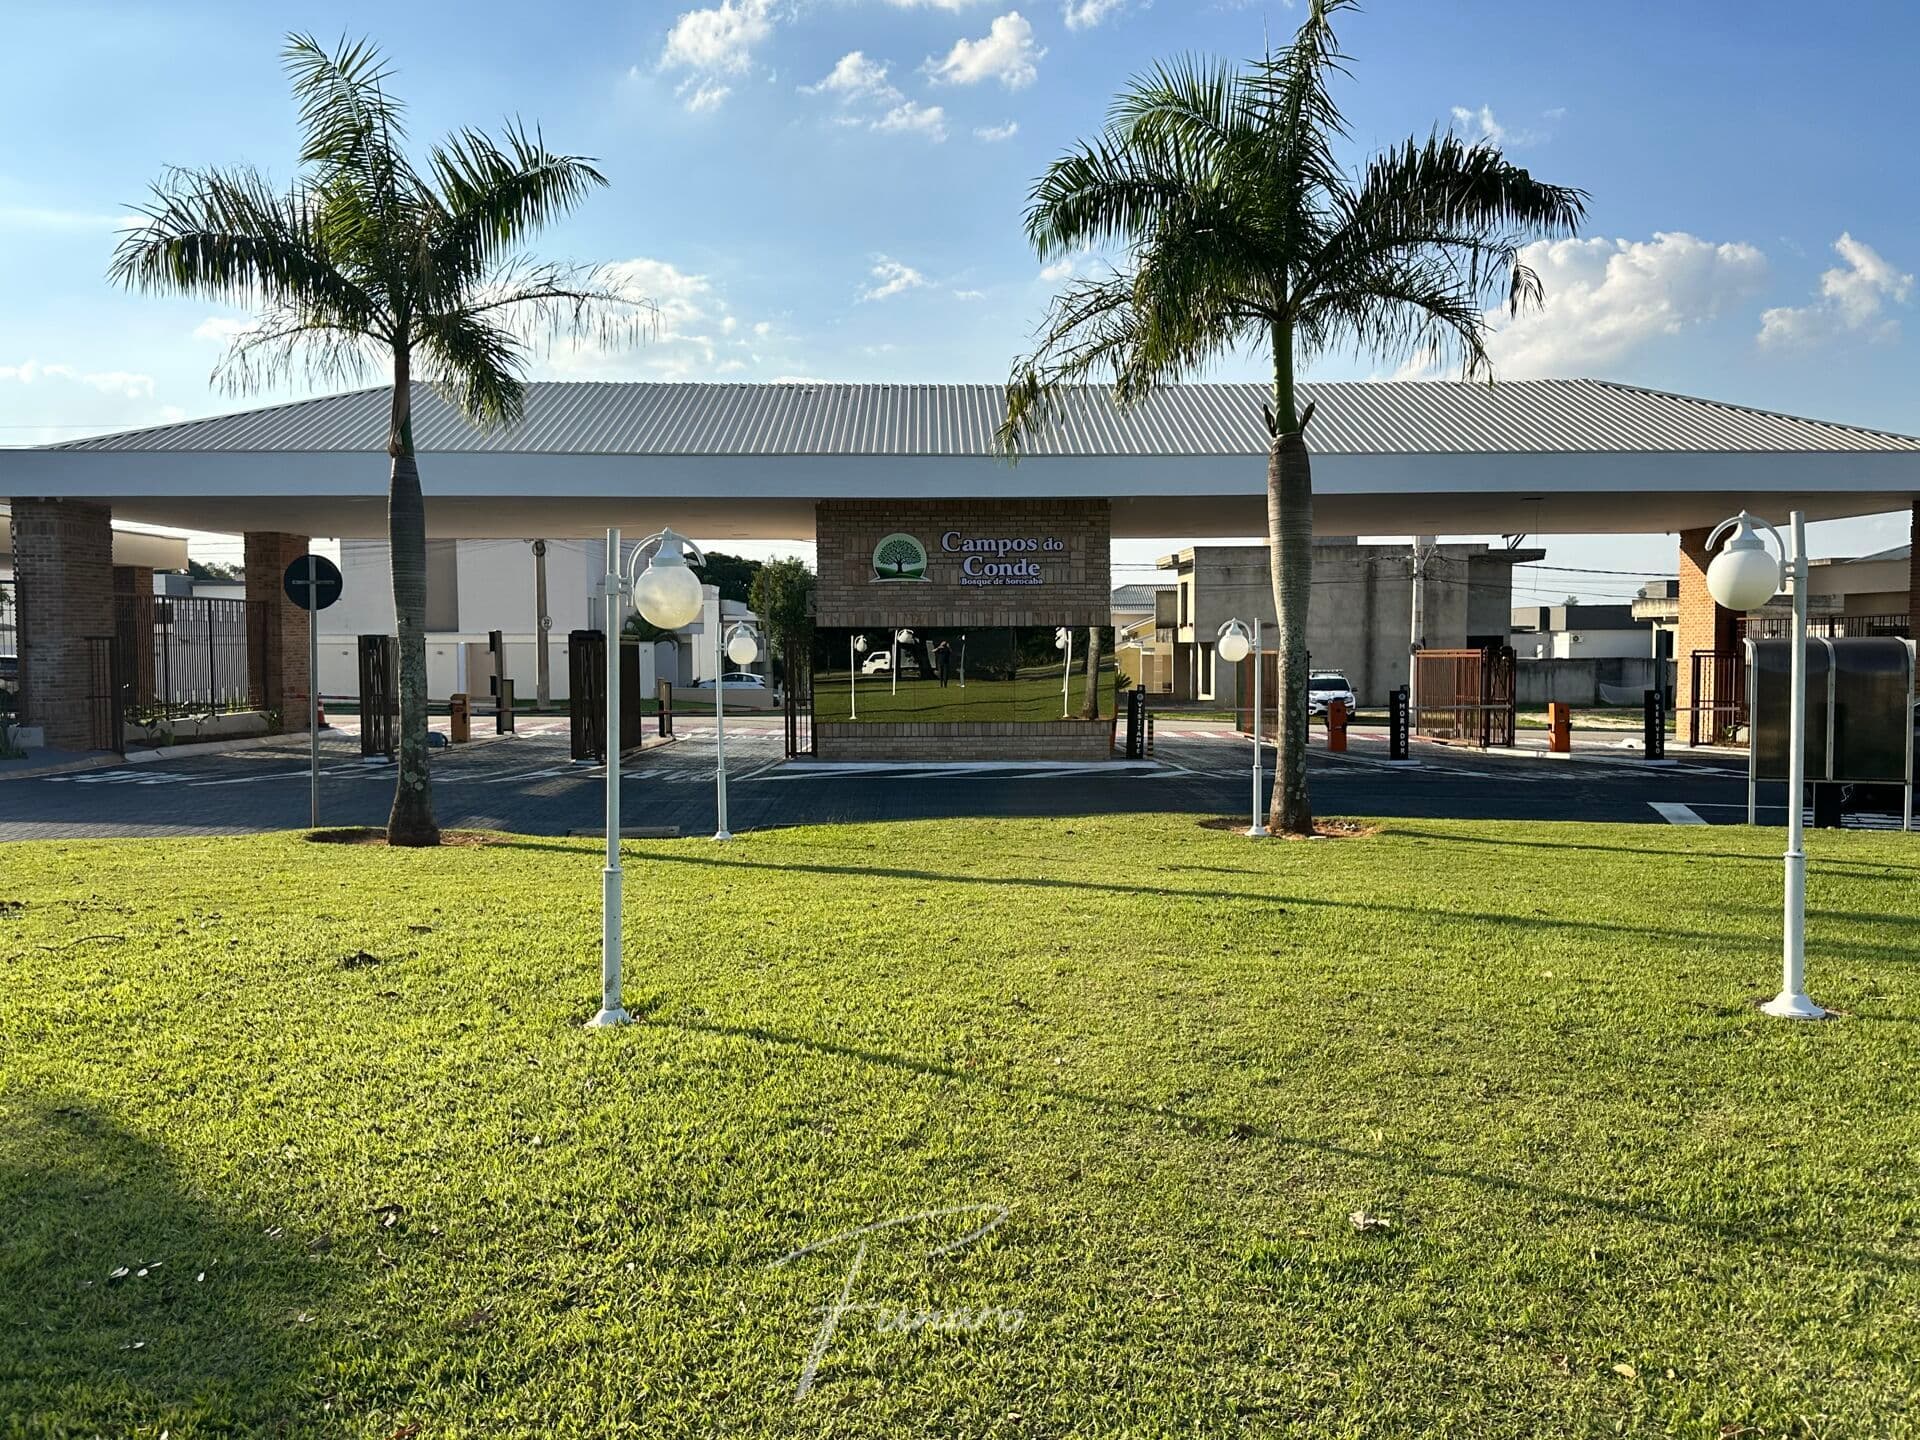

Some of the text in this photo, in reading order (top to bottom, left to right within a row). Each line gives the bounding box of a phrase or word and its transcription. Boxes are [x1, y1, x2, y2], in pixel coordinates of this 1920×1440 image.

[941, 531, 1064, 557] Campos do
[963, 555, 1041, 576] Conde
[960, 577, 1043, 587] Bosque de Sorocaba
